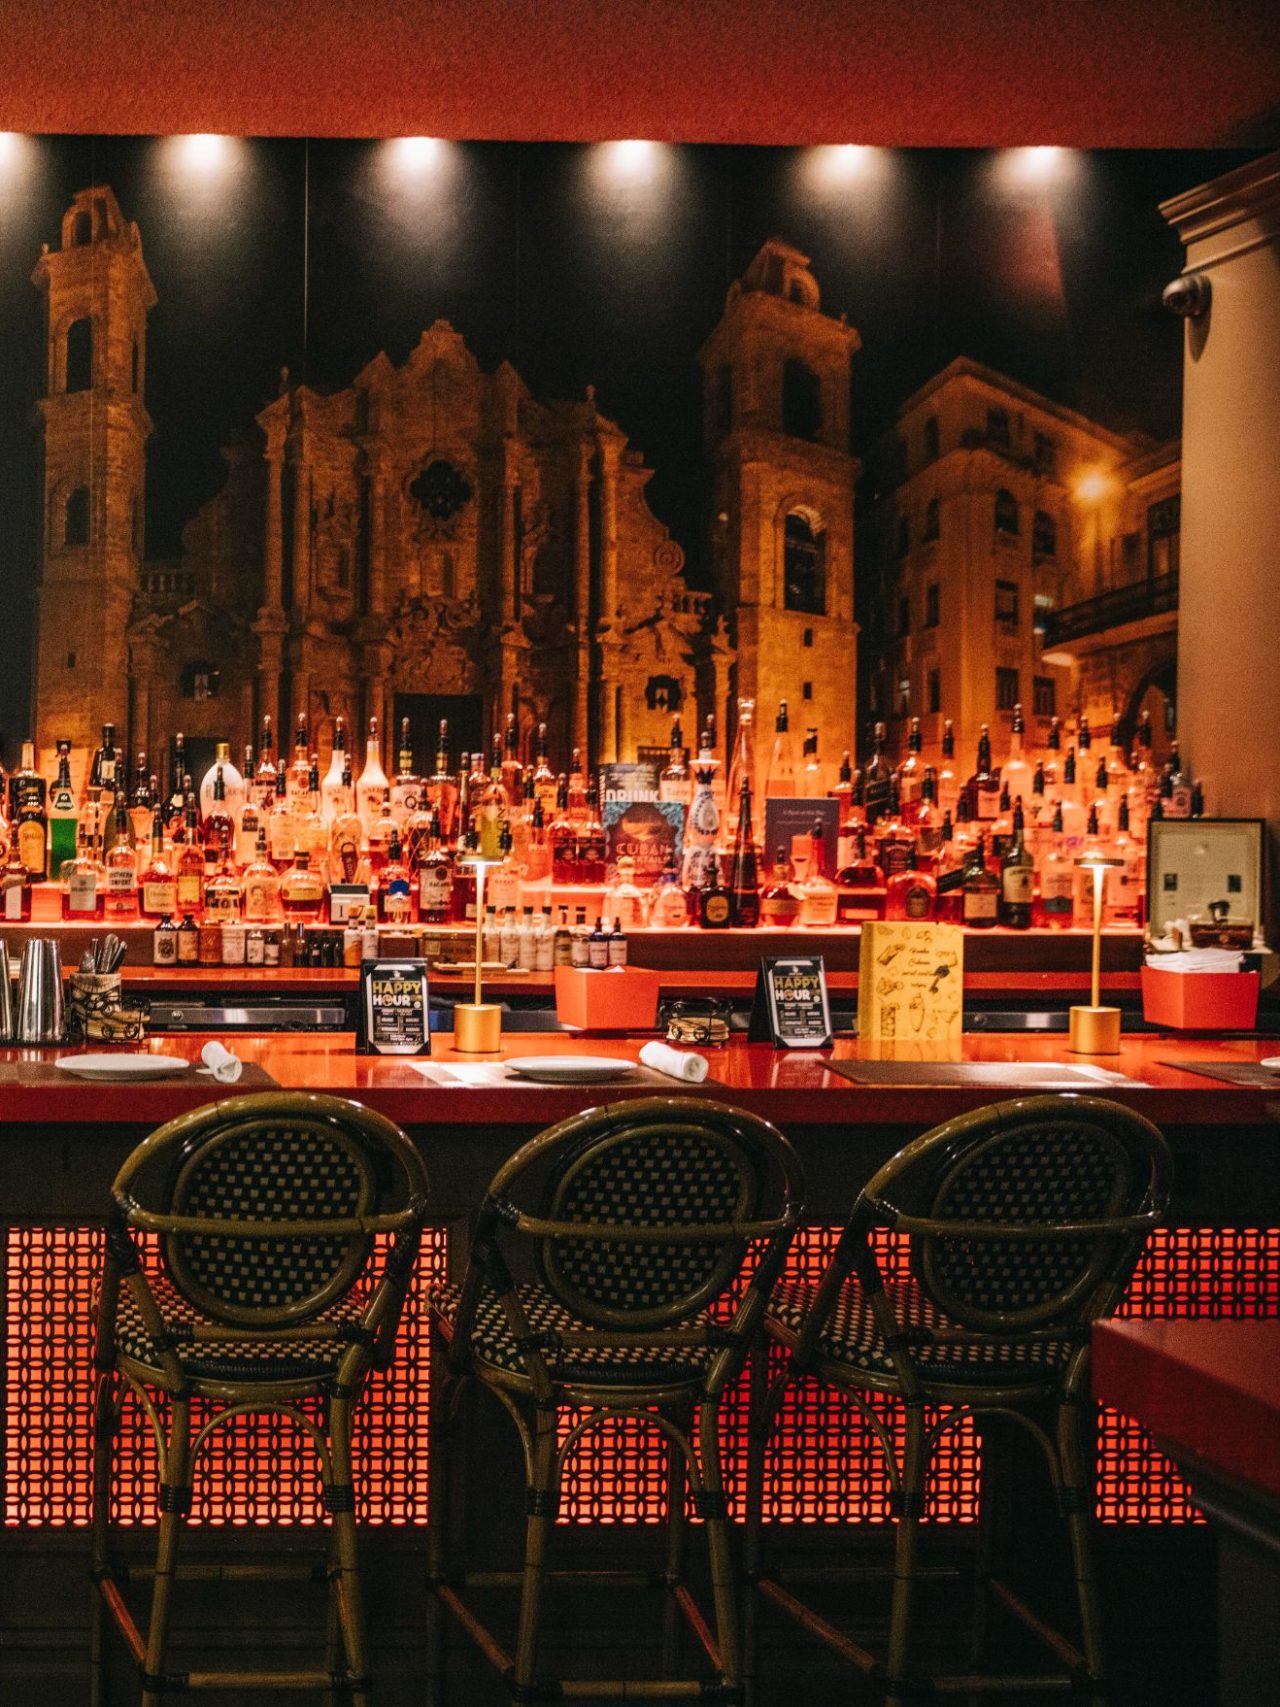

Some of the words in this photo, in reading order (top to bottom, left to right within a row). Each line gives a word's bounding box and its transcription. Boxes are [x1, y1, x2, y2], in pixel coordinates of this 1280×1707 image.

[373, 981, 421, 993] HAPPY
[775, 976, 819, 988] HAPPY
[373, 995, 410, 1006] HOUR
[776, 989, 811, 1001] HOUR
